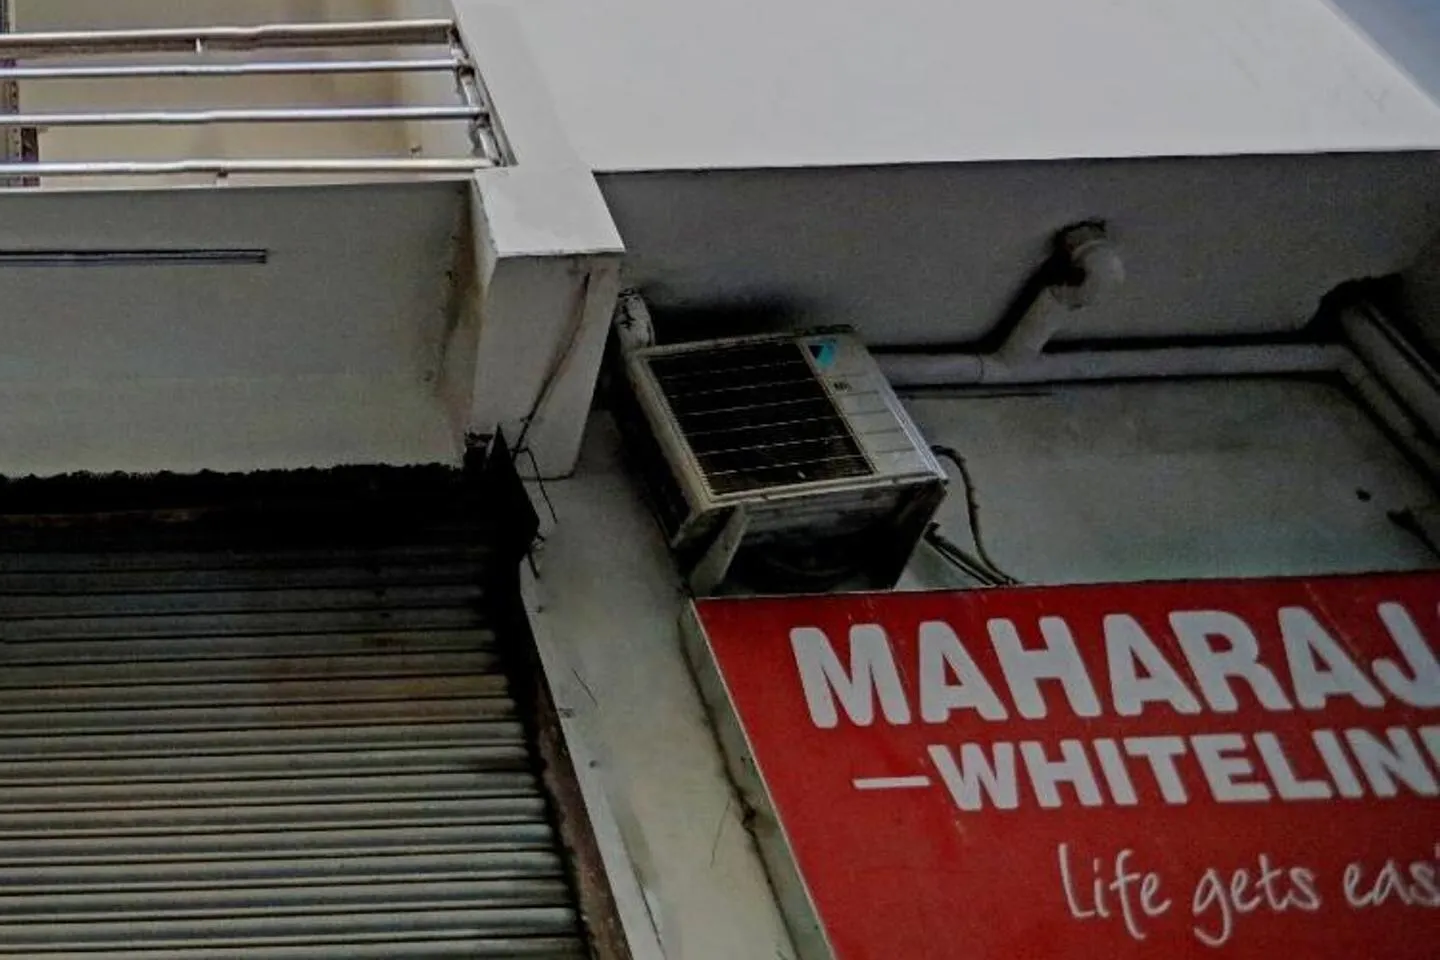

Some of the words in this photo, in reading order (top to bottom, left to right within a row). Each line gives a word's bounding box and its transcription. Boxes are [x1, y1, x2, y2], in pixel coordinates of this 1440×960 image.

[789, 602, 1440, 729] MAHARAJ
[1058, 843, 1172, 940] Life
[1192, 853, 1321, 948] gets
[1343, 842, 1440, 908] eas
